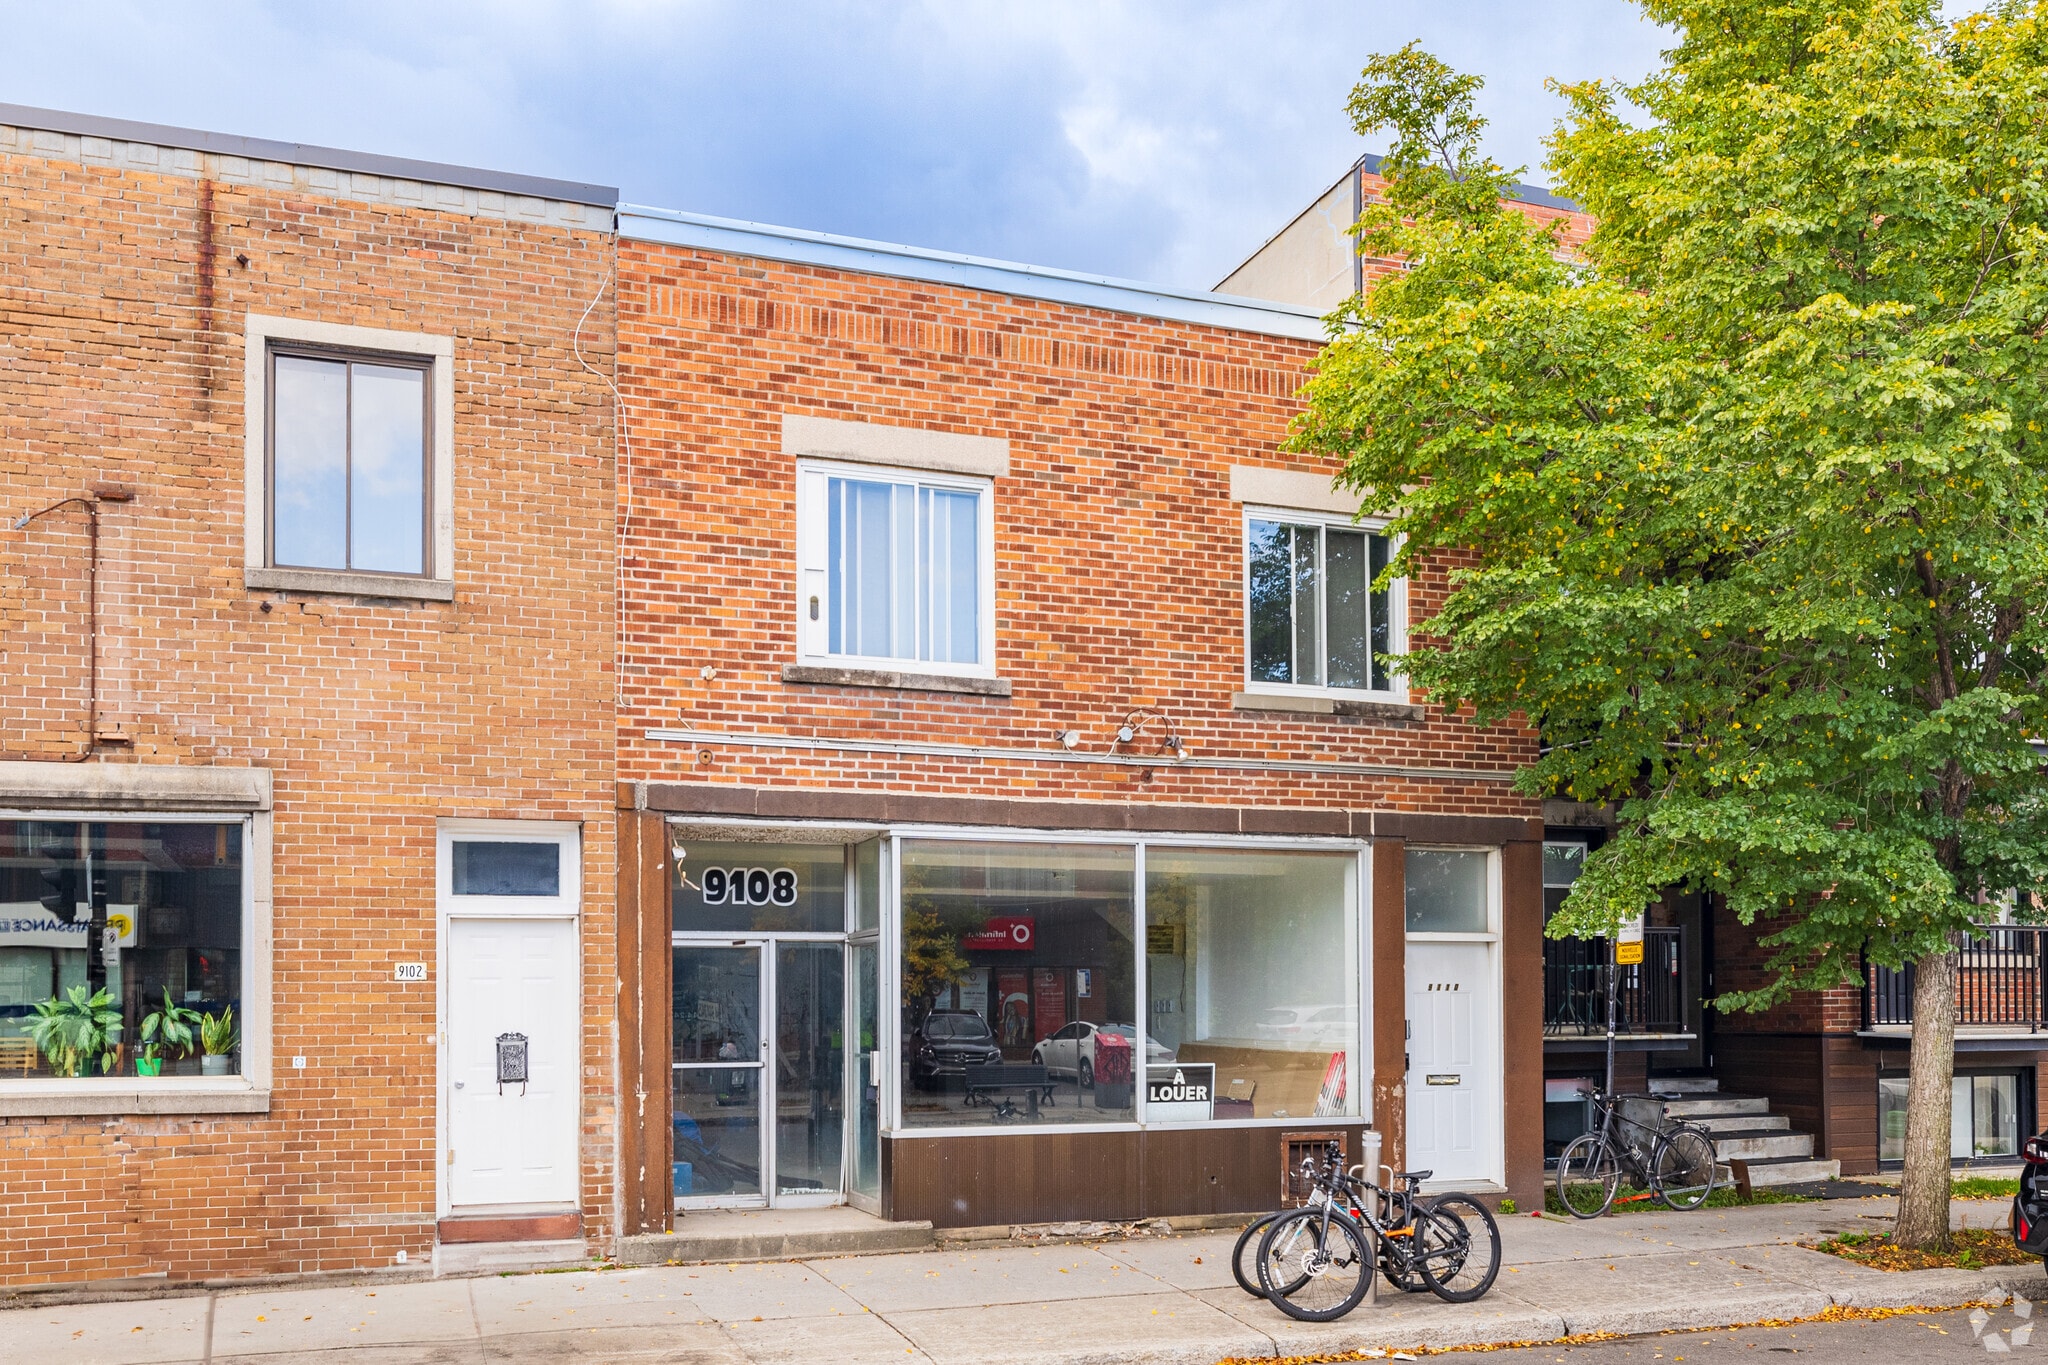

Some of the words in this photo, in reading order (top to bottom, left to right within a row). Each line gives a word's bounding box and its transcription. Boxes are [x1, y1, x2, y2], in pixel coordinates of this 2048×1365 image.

[702, 866, 798, 906] 9108
[398, 965, 423, 977] 9102
[1173, 1068, 1186, 1085] À
[1150, 1085, 1208, 1101] LOUER
